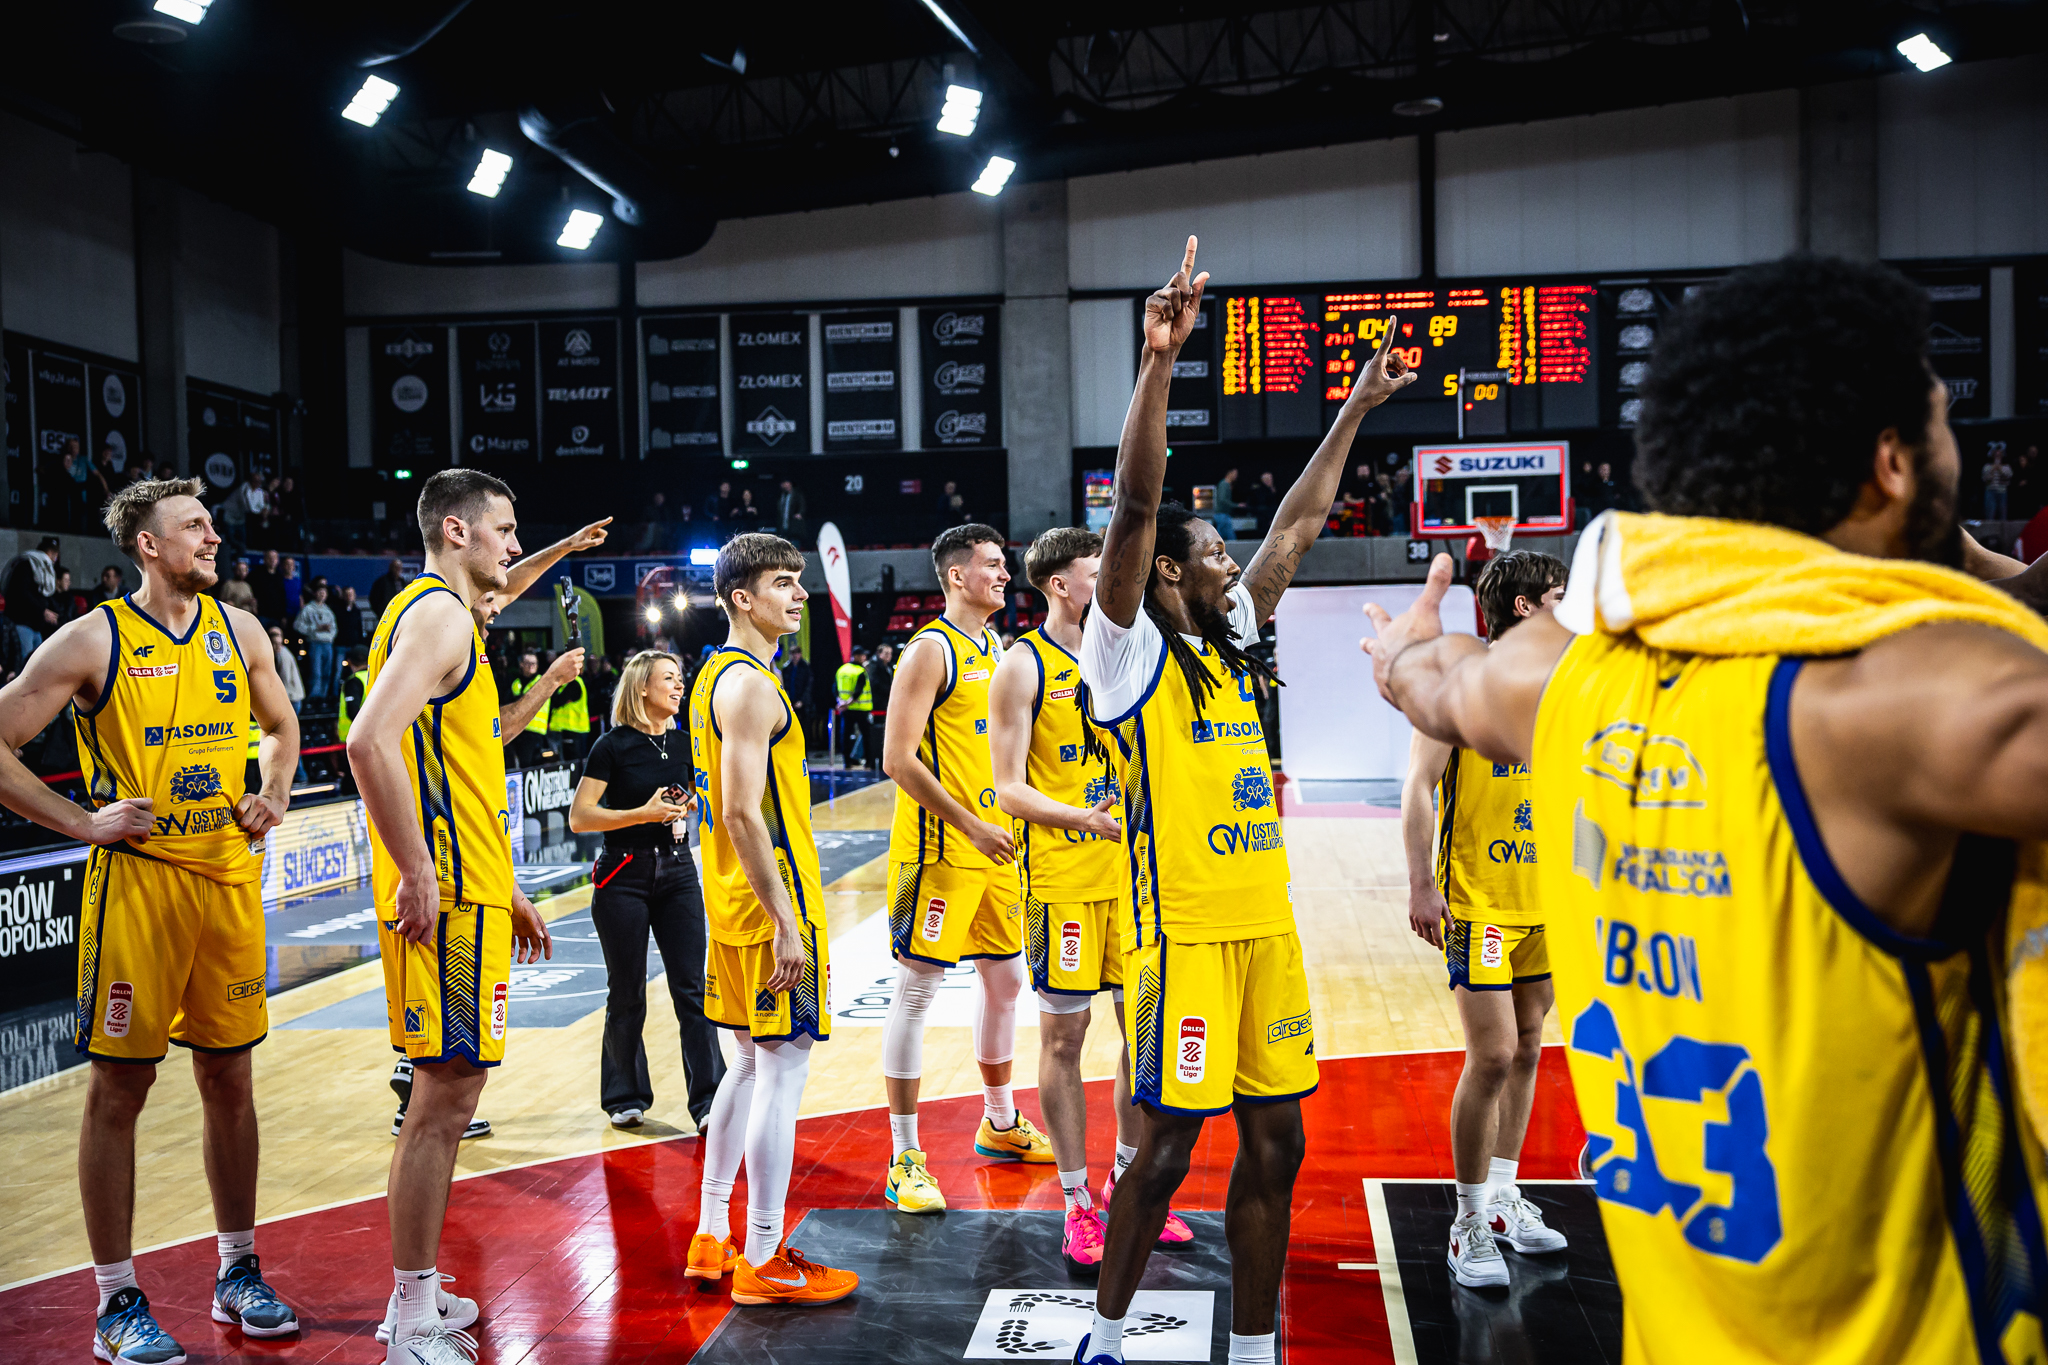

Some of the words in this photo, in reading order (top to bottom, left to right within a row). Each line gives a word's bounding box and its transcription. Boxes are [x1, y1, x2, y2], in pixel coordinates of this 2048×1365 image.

[1358, 319, 1392, 340] 104
[1430, 315, 1459, 337] 89
[1460, 456, 1544, 471] SUZUKI
[844, 475, 863, 491] 20
[1409, 542, 1429, 559] 38
[133, 645, 155, 658] 4F
[129, 667, 153, 677] ORLEN
[1055, 669, 1073, 682] 4F
[213, 670, 237, 703] 5
[1052, 688, 1074, 698] ORLEN
[165, 722, 235, 741] TASOMIX
[284, 840, 349, 891] SUKCESY
[111, 988, 132, 996] ORLEN
[106, 1021, 128, 1029] Basket
[1182, 1025, 1205, 1033] ORLEN
[1180, 1064, 1202, 1072] Basket
[1183, 1071, 1198, 1079] Liga
